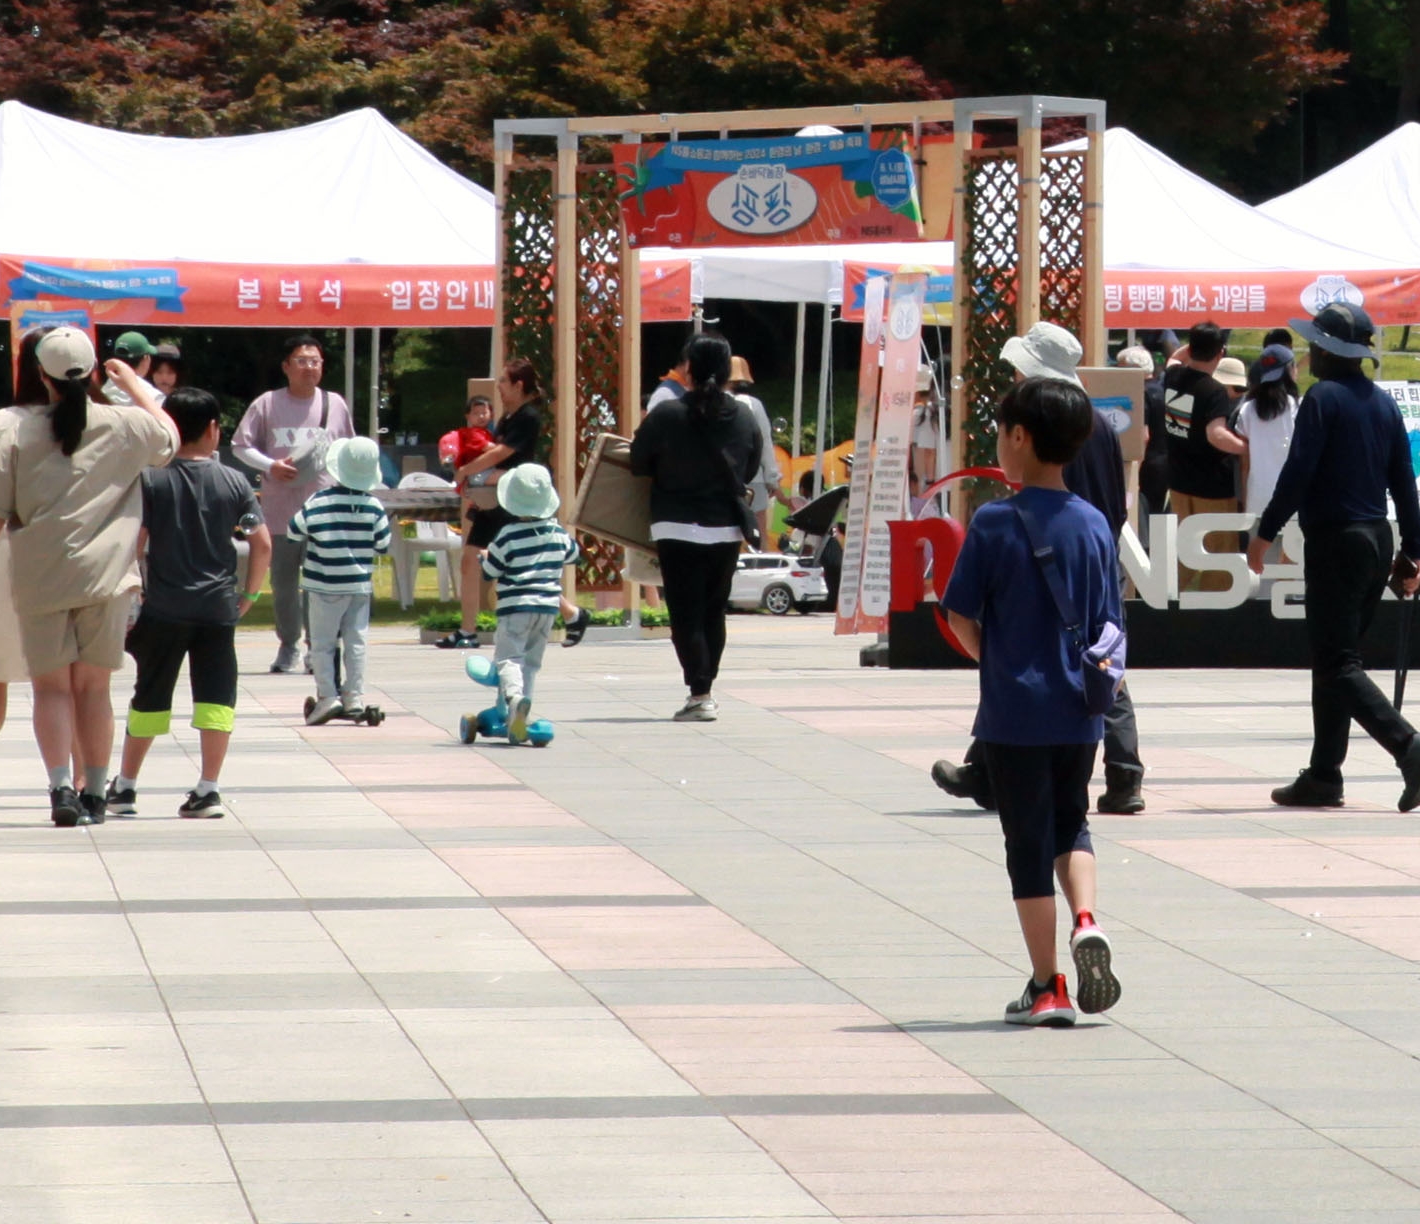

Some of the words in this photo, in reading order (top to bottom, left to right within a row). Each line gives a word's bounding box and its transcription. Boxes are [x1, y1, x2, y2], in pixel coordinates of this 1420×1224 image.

[390, 279, 495, 310] 입장안내
[1128, 284, 1165, 312] 탱탱
[1170, 284, 1207, 312] 채소
[1211, 284, 1266, 312] 과일들
